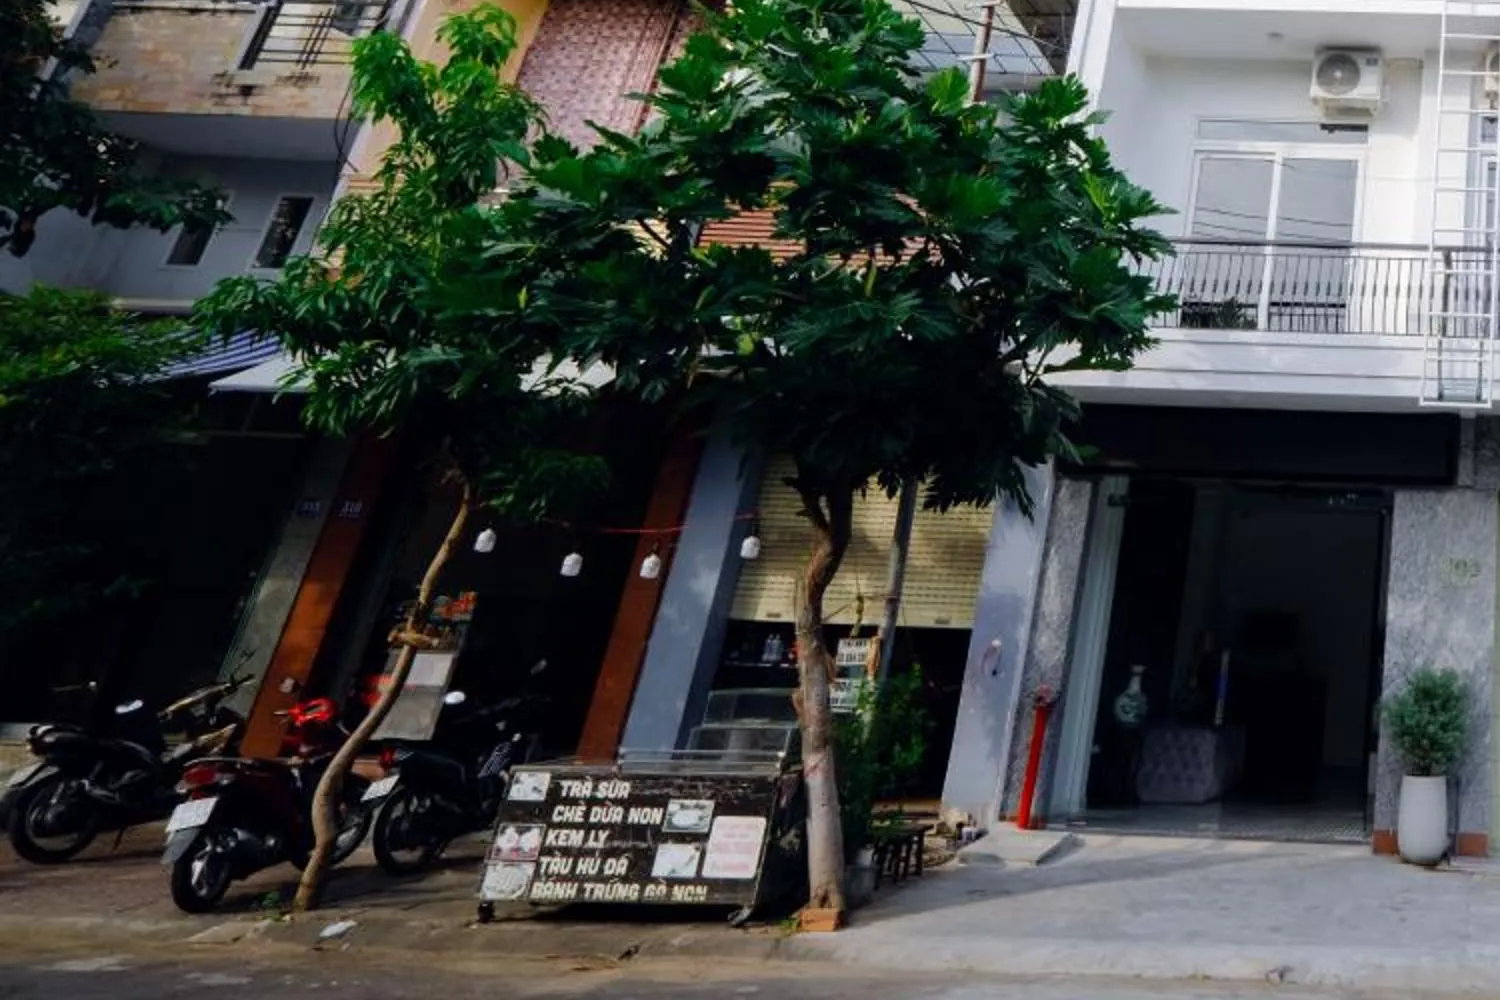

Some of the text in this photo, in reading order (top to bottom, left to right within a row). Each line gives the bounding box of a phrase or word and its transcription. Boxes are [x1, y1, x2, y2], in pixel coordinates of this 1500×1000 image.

[627, 807, 665, 825] NON
[545, 829, 610, 849] KEM LY
